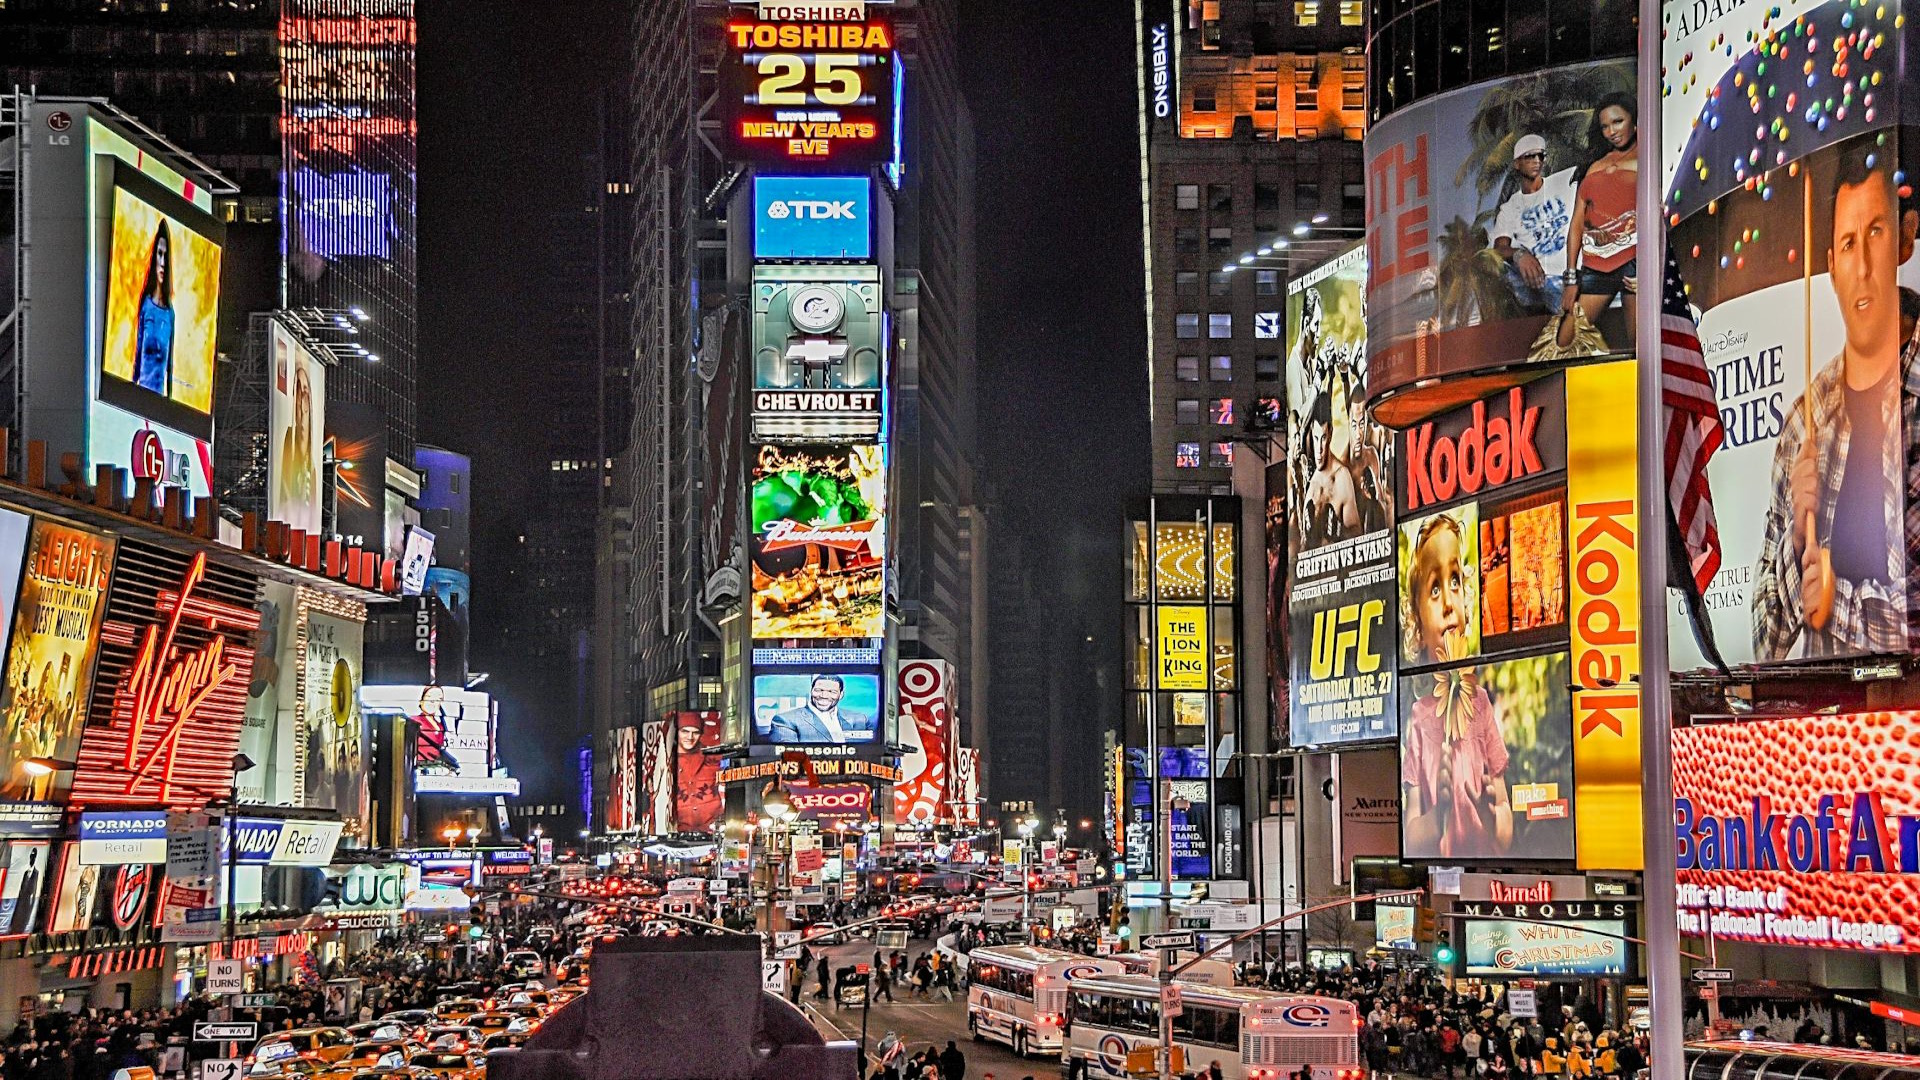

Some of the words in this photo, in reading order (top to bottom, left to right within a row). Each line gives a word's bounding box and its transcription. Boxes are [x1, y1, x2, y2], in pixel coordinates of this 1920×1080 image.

[762, 6, 863, 21] TOSHIBA
[729, 25, 890, 49] TOSHIBA
[757, 53, 862, 105] 25
[1151, 22, 1170, 118] ONSIBLY.
[776, 111, 807, 122] DAYS
[807, 111, 841, 122] UNTIL
[742, 122, 797, 138] NEW
[799, 122, 875, 138] YEAR'S
[48, 135, 71, 146] LG
[787, 139, 830, 155] EVE
[787, 200, 857, 220] TDK
[1287, 276, 1303, 295] THE
[1708, 345, 1785, 401] TIME
[756, 393, 876, 411] CHEVROLET
[1720, 391, 1784, 451] RIES
[1406, 386, 1545, 510] Kodak
[761, 520, 874, 543] Budweiser
[33, 533, 112, 592] HEIGHTS
[1296, 550, 1340, 579] GRIFFIN
[1339, 546, 1354, 568] VS
[1354, 536, 1392, 564] EVANS
[1343, 573, 1372, 593] JACKSON
[32, 603, 56, 635] BEST
[54, 608, 89, 641] MUSICAL
[415, 596, 430, 652] 1500
[1168, 622, 1196, 634] THE
[1575, 500, 1639, 739] Kodak
[1163, 636, 1201, 656] LION
[1309, 600, 1385, 681] UFC
[125, 551, 237, 802] Virgin
[1163, 658, 1202, 678] KING
[1299, 677, 1353, 706] SATURDAY,
[1352, 673, 1378, 698] DEC.
[1378, 671, 1393, 695] 27
[775, 745, 856, 756] Pasonic
[1515, 785, 1548, 806] make
[1530, 802, 1565, 817] something
[82, 819, 167, 830] VORNADO
[1170, 824, 1198, 832] START
[1674, 795, 1788, 873] Bank
[1787, 794, 1838, 874] of
[187, 842, 208, 850] PEACE
[222, 827, 279, 853] NADO
[284, 830, 330, 855] Retail
[1170, 841, 1188, 849] OCK
[1190, 841, 1207, 849] THE
[1174, 832, 1203, 841] BAND.
[1225, 808, 1233, 874] ROCKBAND.COM
[104, 842, 143, 853] Retail
[1725, 887, 1766, 909] Bank
[1766, 887, 1786, 909] of
[1464, 904, 1626, 918] MARQUIS
[337, 915, 390, 929] swatch
[1183, 919, 1189, 928] W
[1191, 919, 1200, 928] 46
[1764, 915, 1831, 940] Football
[1831, 916, 1901, 947] League
[1147, 938, 1164, 946] ONE
[1170, 936, 1188, 944] WAY
[1517, 924, 1584, 942] WHITE
[211, 938, 250, 960] PLET
[251, 932, 307, 957] HWOOD
[1494, 939, 1615, 970] CHRISTMAS
[217, 965, 232, 975] NO
[209, 979, 240, 988] TURNS
[245, 998, 252, 1006] W
[253, 997, 264, 1005] 46
[1166, 989, 1176, 998] NO
[1164, 999, 1181, 1010] TURNS
[207, 1063, 225, 1073] NO
